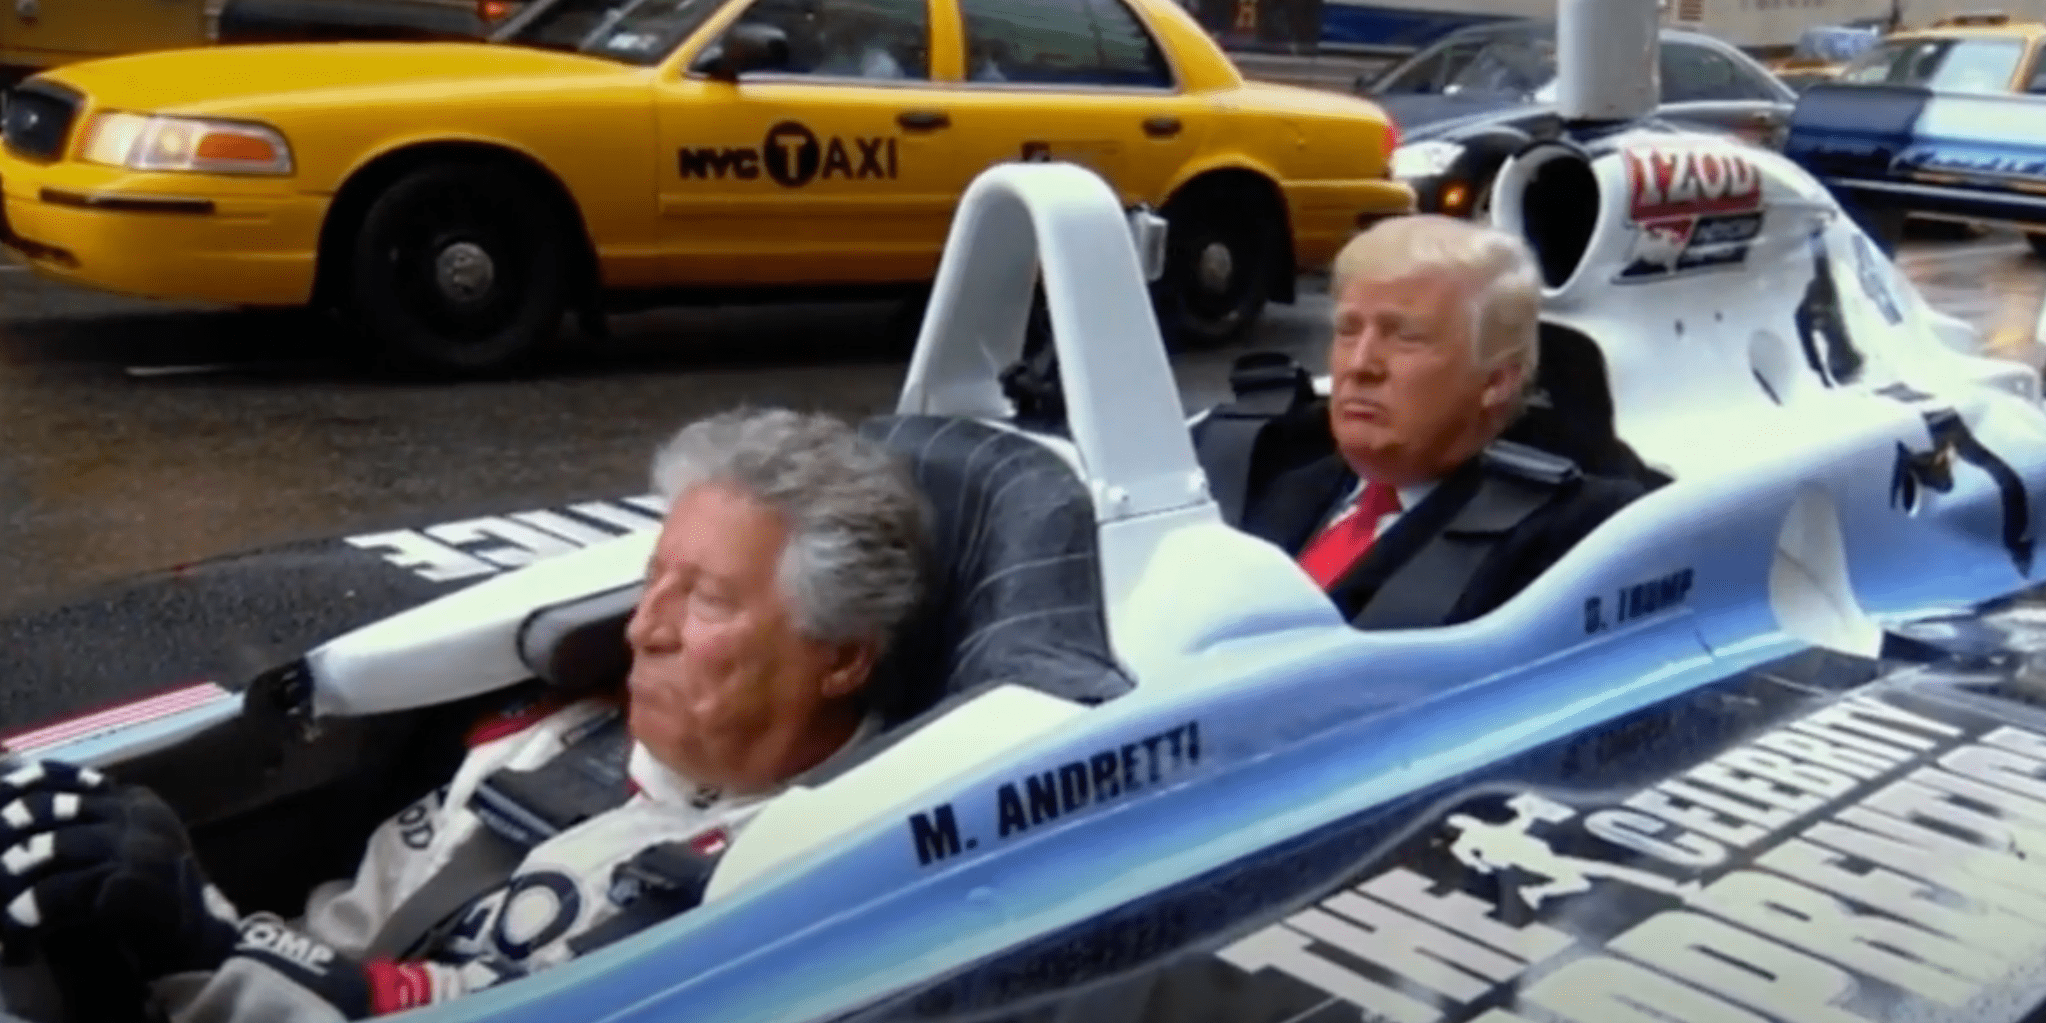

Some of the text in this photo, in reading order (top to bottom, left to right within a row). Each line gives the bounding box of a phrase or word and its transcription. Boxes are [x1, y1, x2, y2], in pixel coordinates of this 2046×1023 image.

[678, 127, 898, 184] NYC TAXI
[1631, 148, 1757, 205] IZOD
[908, 720, 1199, 867] M. ANDRETTI
[1214, 867, 1578, 1023] THE
[1583, 692, 1963, 867] CELEBRITY
[242, 920, 335, 976] OMP
